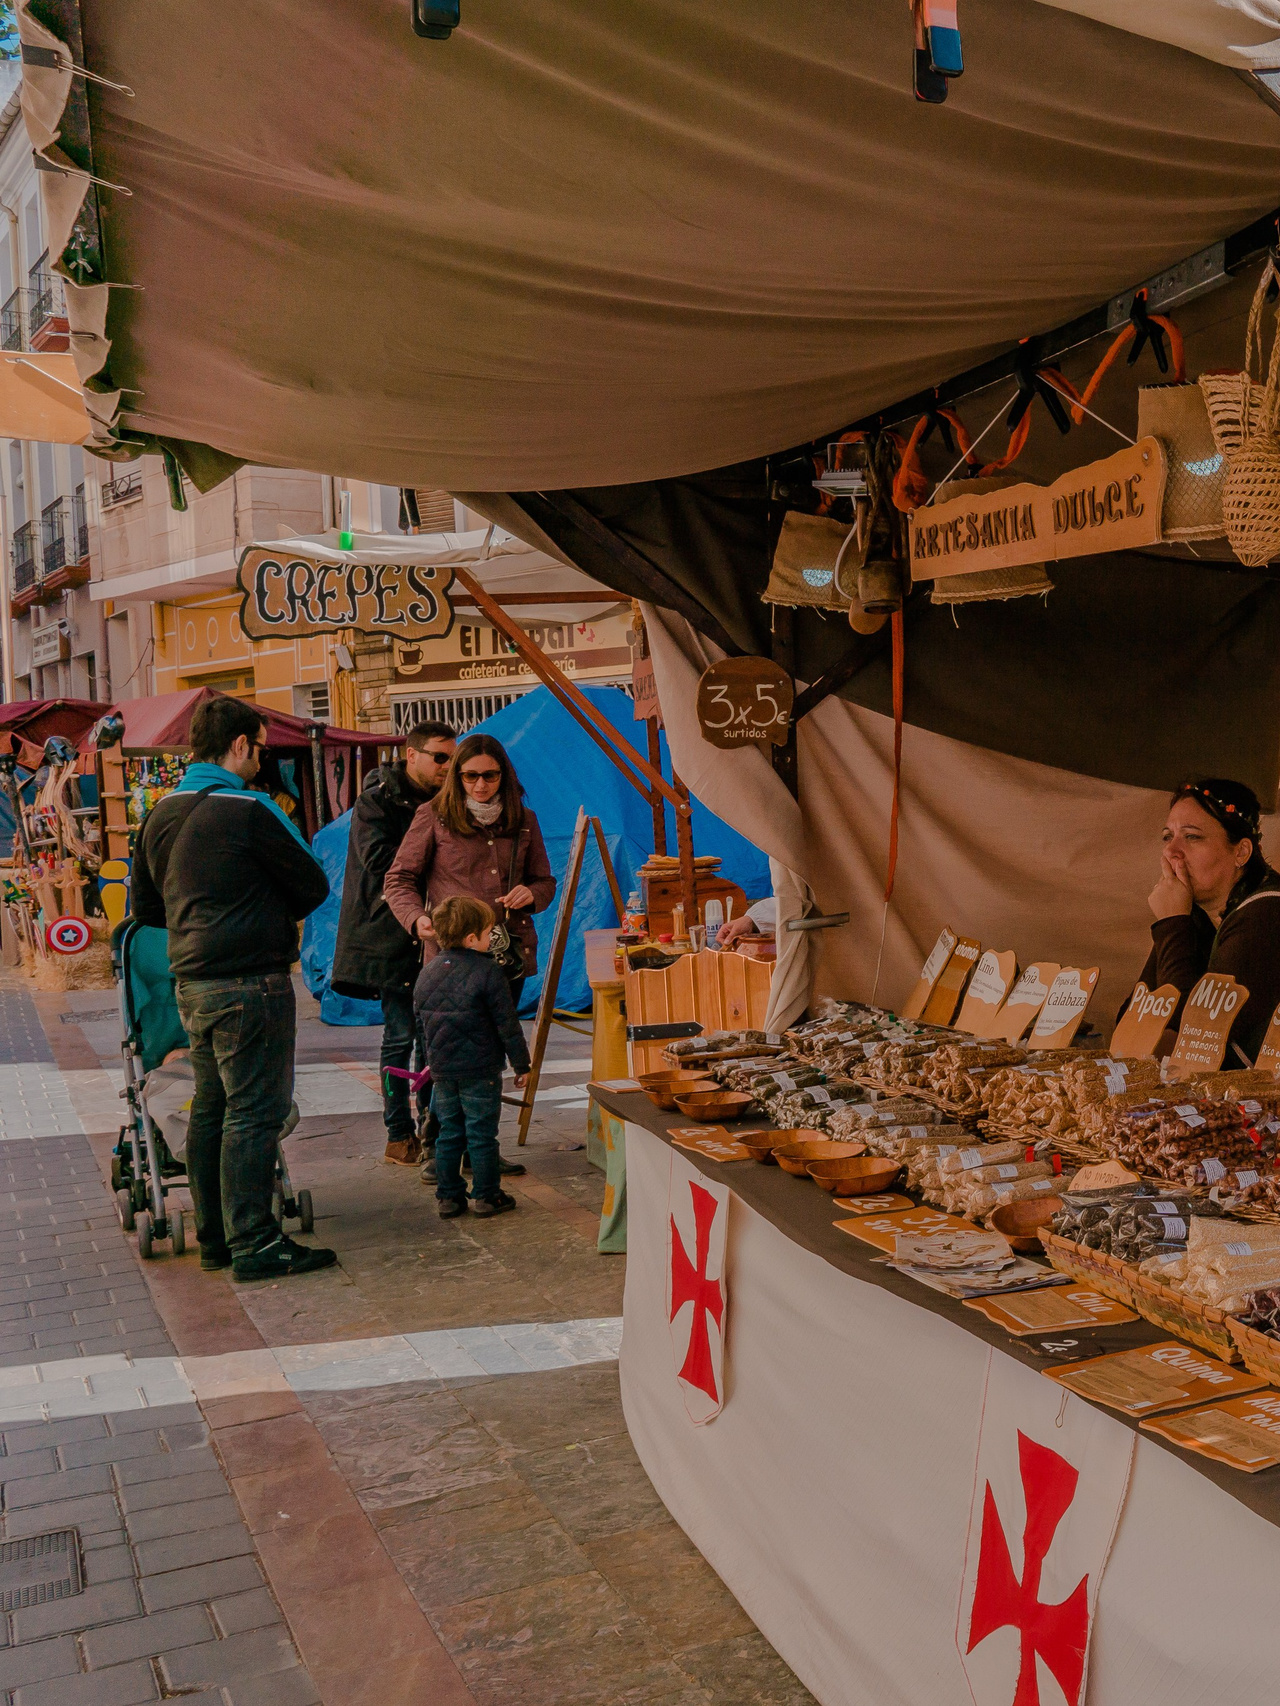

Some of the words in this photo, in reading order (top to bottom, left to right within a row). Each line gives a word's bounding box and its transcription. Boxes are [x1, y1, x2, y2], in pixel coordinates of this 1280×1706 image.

[913, 503, 1036, 559] ARTESANIA
[1052, 473, 1144, 535] DULCE
[459, 625, 481, 657] El
[459, 661, 508, 680] cafetería
[518, 655, 576, 675] ceería
[723, 728, 767, 738] surtidos
[978, 957, 994, 976] Lino
[1019, 970, 1037, 987] Soja
[1055, 976, 1070, 988] Pipas
[1070, 977, 1079, 986] de
[1047, 991, 1087, 1007] Calabaza
[1128, 984, 1175, 1022] Pipas
[1190, 979, 1238, 1020] Mijo
[1182, 1023, 1202, 1036] Bueno
[1178, 1038, 1186, 1047] la
[1261, 1044, 1275, 1057] Rico
[1174, 1048, 1182, 1059] la
[1185, 1051, 1211, 1065] anemia
[850, 1195, 895, 1210] 2€
[864, 1219, 921, 1237] surt
[1151, 1347, 1234, 1384] Quinoa
